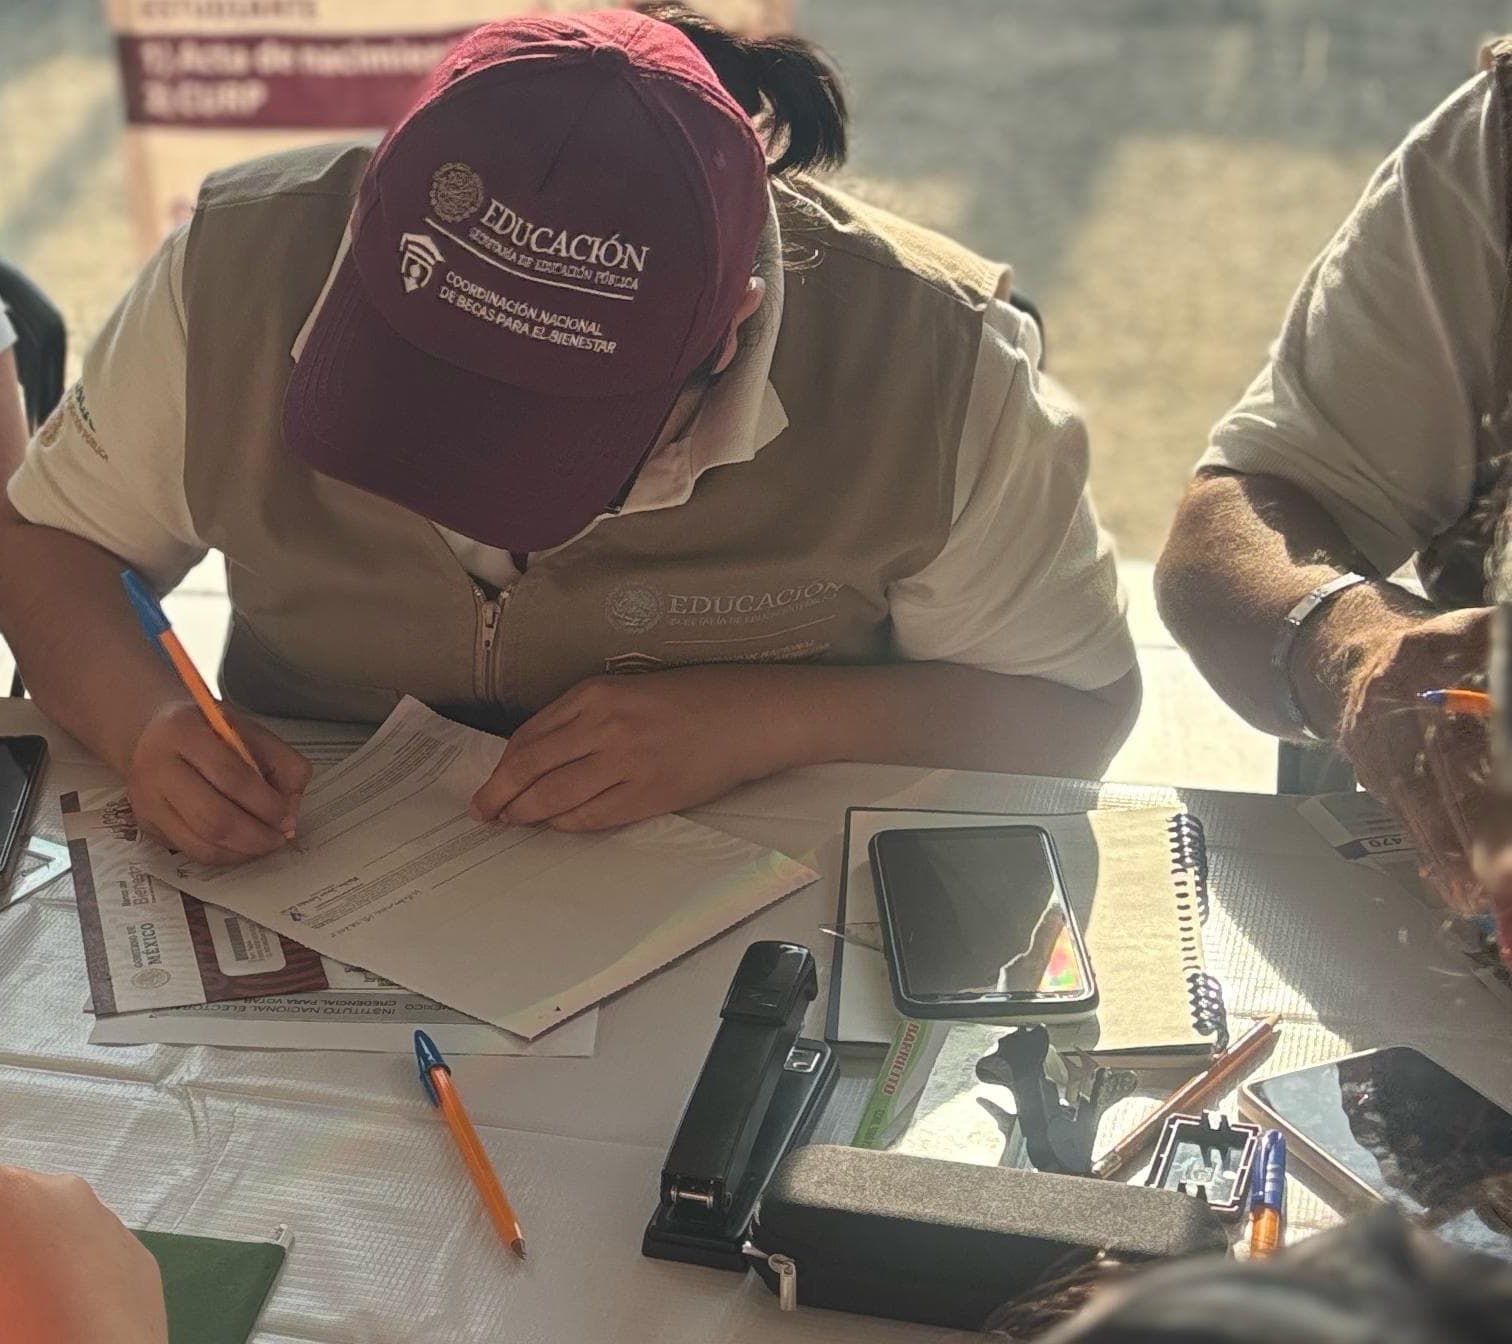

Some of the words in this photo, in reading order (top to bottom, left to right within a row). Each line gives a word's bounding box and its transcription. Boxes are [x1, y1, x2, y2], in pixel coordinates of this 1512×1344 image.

[480, 198, 650, 271] EDUCACIÓN
[594, 271, 638, 290] PÚBLICA
[446, 271, 539, 319] COORDINACIÓN
[539, 311, 602, 336] NACIONAL
[440, 286, 455, 303] DE
[456, 296, 495, 321] BECAS
[496, 313, 529, 334] PARA
[531, 327, 546, 339] EL
[549, 330, 616, 354] BIENESTAR
[140, 922, 162, 966] MÉXICO
[251, 1005, 320, 1015] NACIONAL
[287, 998, 323, 1006] PARA
[323, 1006, 396, 1015] INSTITUTO
[325, 999, 397, 1007] CREDENCIAL
[884, 1023, 920, 1095] BARRILITO
